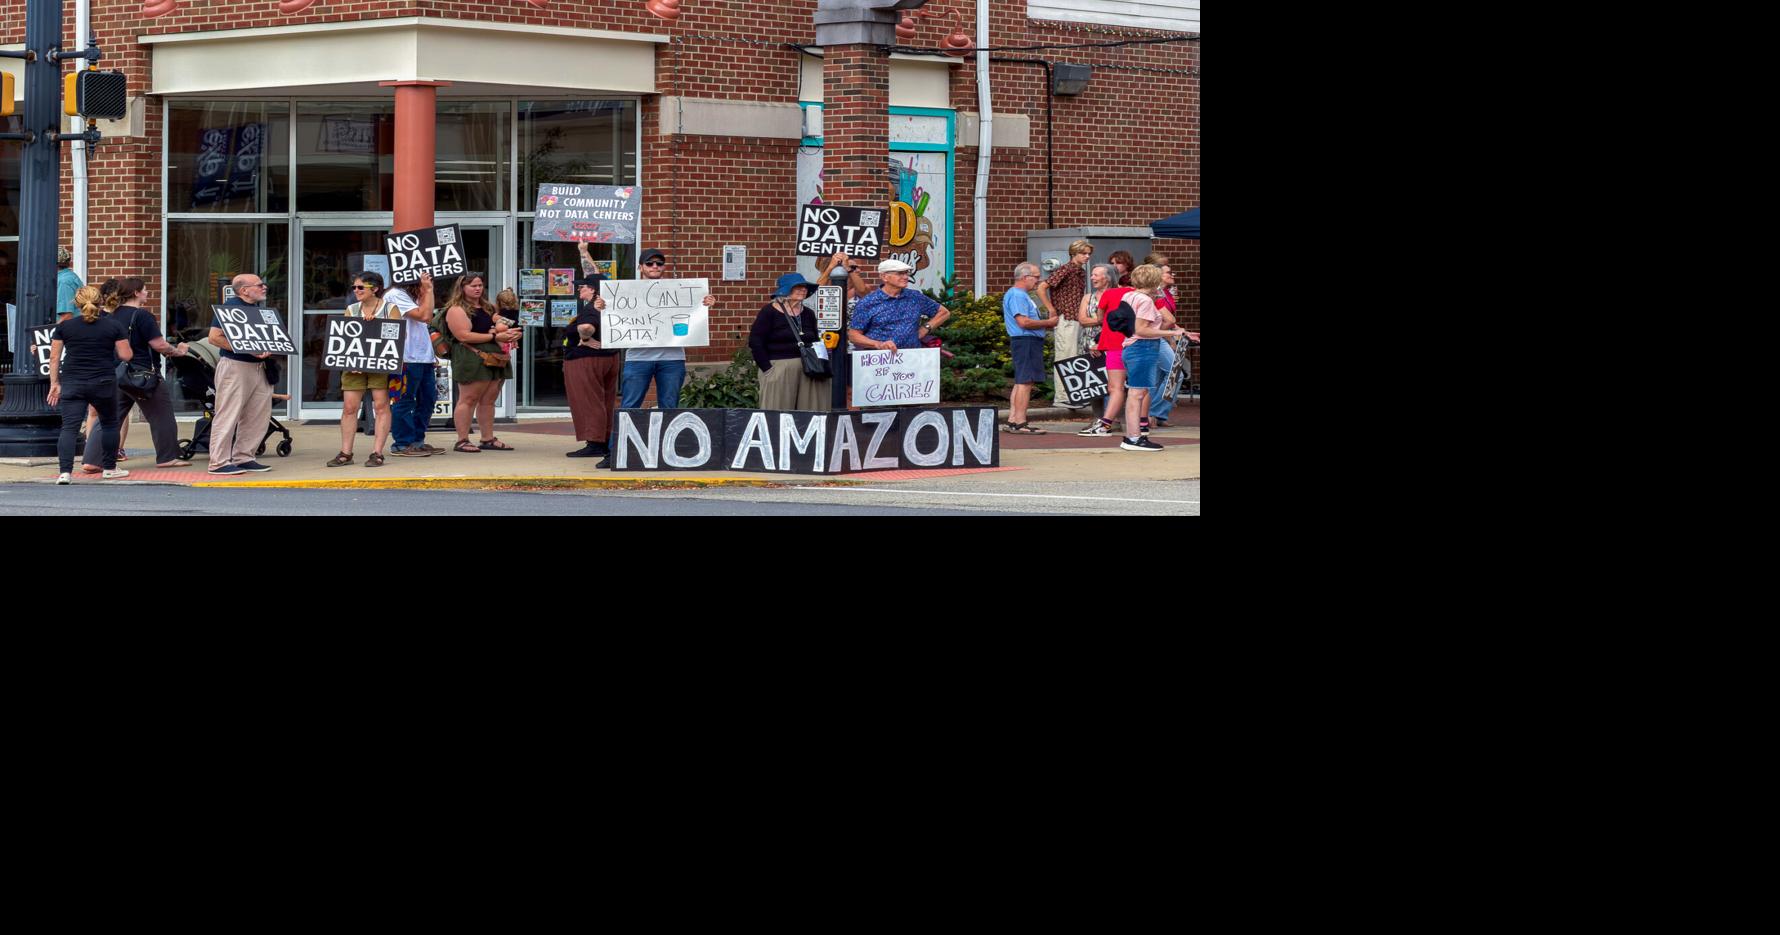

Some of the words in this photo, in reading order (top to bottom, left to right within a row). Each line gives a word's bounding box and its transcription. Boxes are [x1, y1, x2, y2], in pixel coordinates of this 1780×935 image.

[552, 187, 581, 195] BUILD
[563, 198, 627, 208] COMMUNITY
[540, 209, 560, 218] NOT
[565, 210, 589, 219] DATA
[593, 211, 634, 220] CENTERS
[804, 208, 840, 225] NO
[801, 223, 879, 245] DATA
[387, 234, 420, 253] NO
[798, 242, 878, 256] CENTERS
[390, 244, 462, 271] DATA
[217, 308, 248, 323] NO
[224, 323, 289, 341] DATA
[330, 320, 363, 337] NO
[610, 326, 658, 343] DATA!
[232, 340, 294, 352] CENTERS
[327, 336, 399, 358] DATA
[325, 355, 398, 370] CENTERS
[860, 352, 904, 367] HONK
[1058, 358, 1090, 376] NO
[865, 380, 934, 402] CARE!
[1070, 384, 1108, 401] CENT
[433, 404, 450, 414] ST
[615, 411, 711, 469] NO
[731, 409, 995, 472] AMAZON
